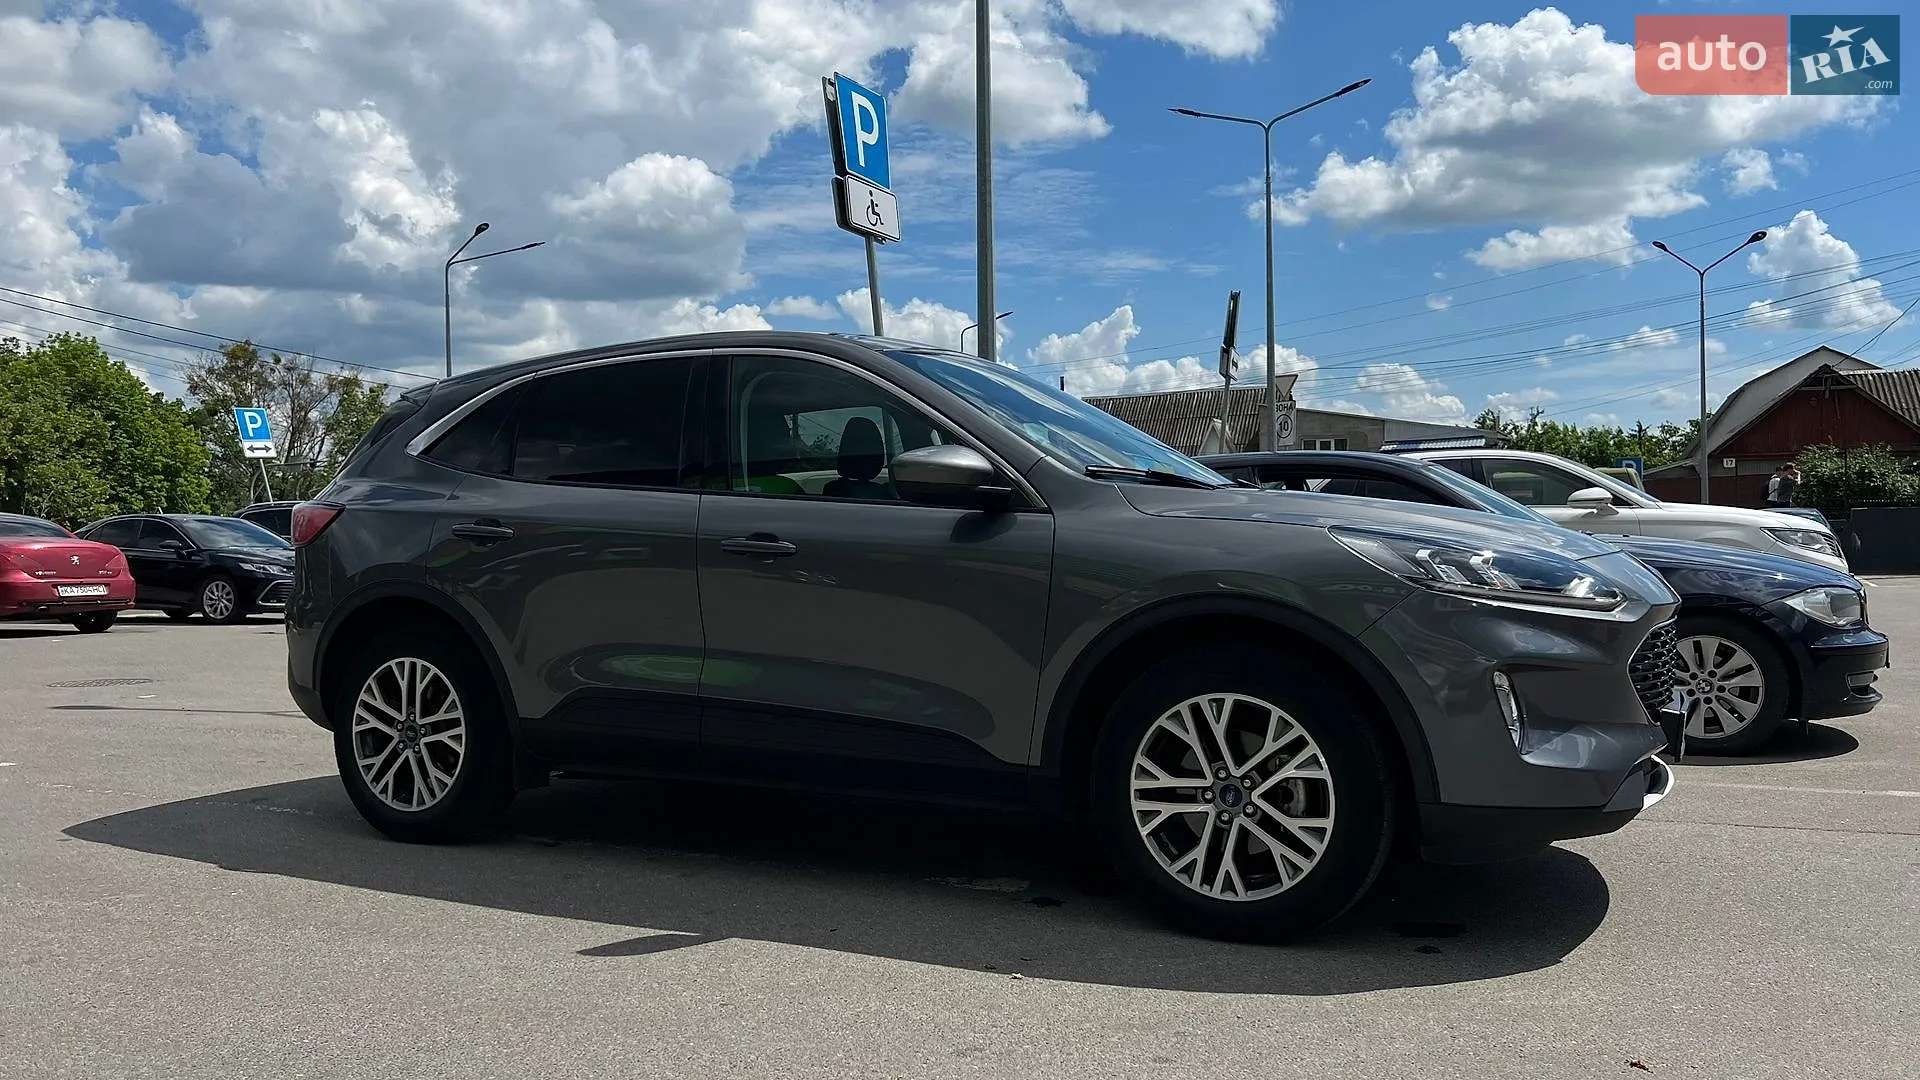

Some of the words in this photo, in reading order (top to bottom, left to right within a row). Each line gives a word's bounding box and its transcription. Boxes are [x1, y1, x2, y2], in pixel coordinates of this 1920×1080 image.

[851, 91, 879, 168] P
[244, 411, 262, 437] P
[1279, 421, 1289, 432] 10
